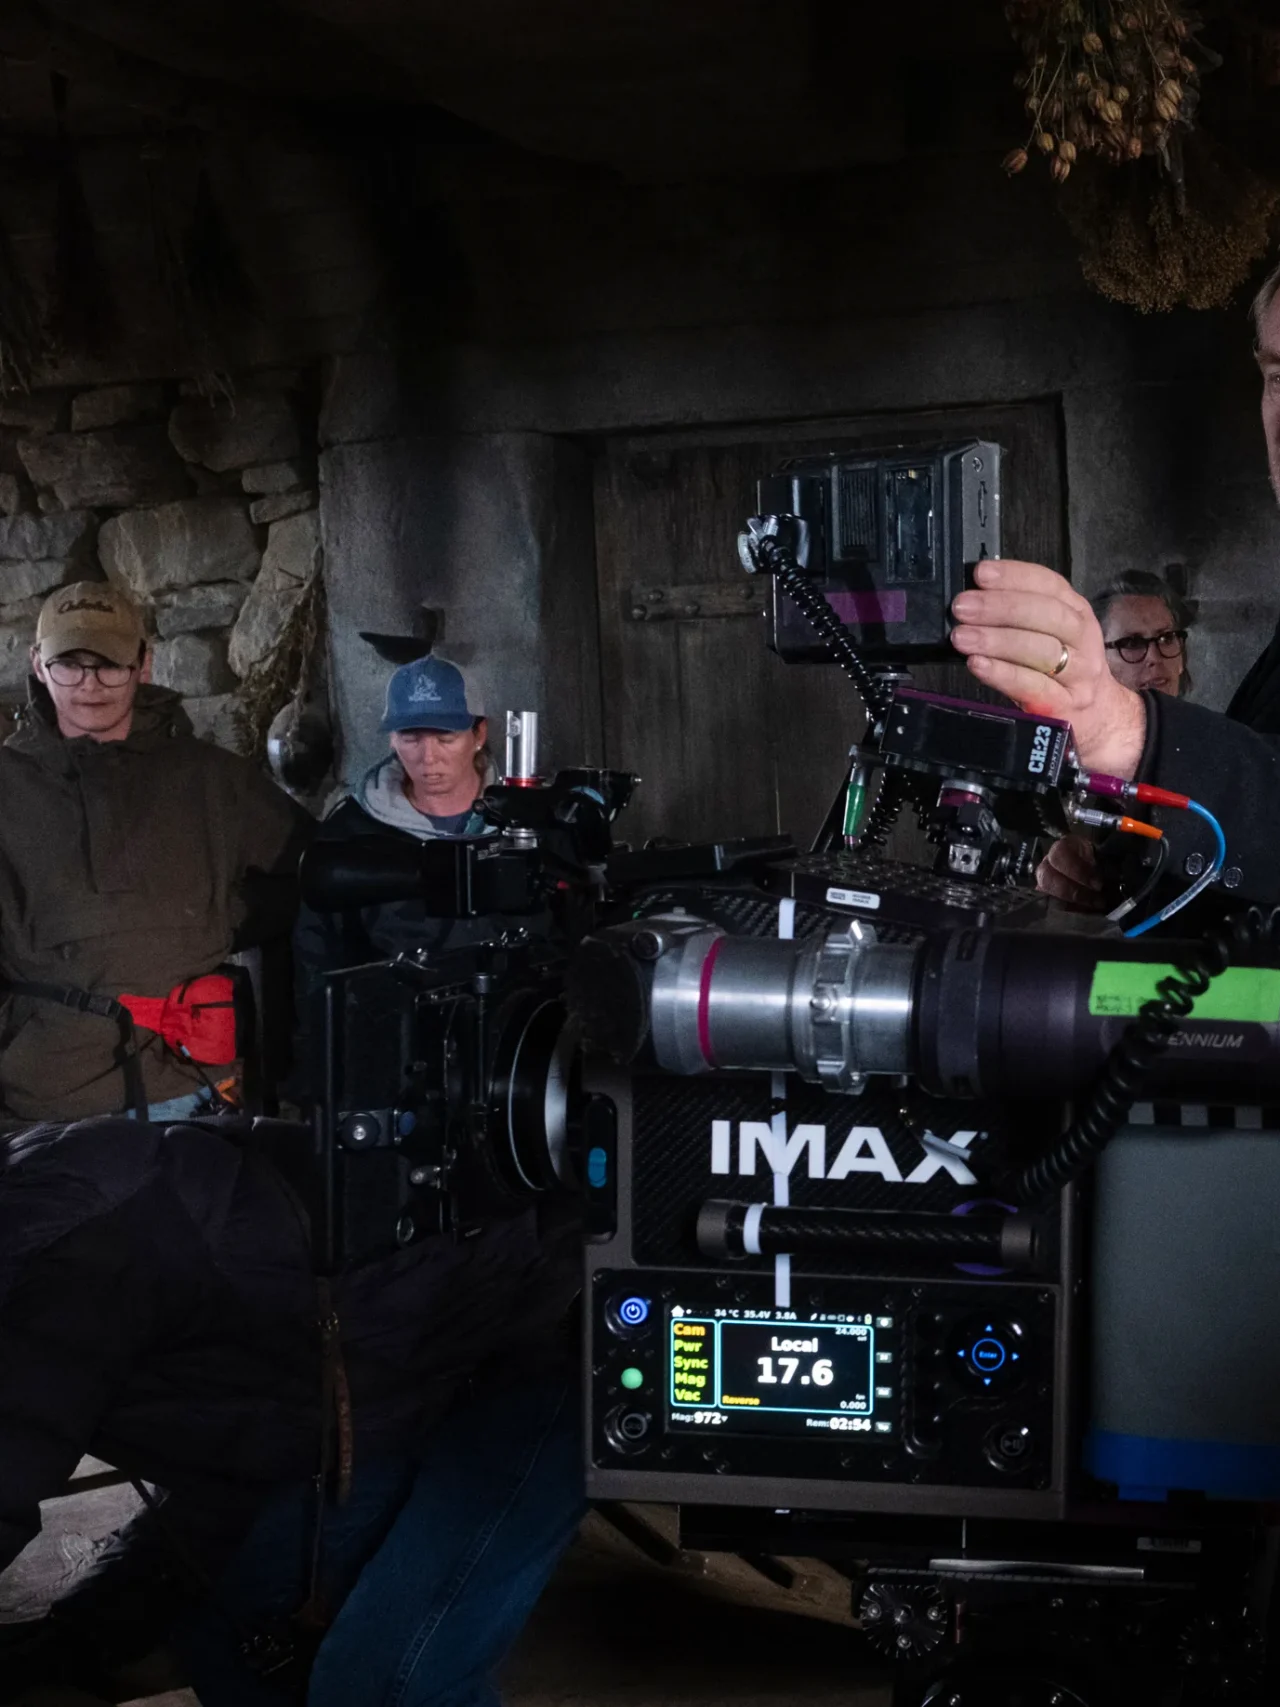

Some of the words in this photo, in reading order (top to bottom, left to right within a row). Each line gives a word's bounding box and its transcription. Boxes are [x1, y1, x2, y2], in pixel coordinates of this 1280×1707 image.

[1027, 725, 1052, 774] CH:23
[710, 1117, 980, 1187] IMAX
[673, 1322, 706, 1337] Cam
[673, 1339, 703, 1352] Pwr
[770, 1335, 819, 1353] Local
[673, 1355, 709, 1370] Sync
[757, 1356, 834, 1387] 17.6
[674, 1372, 706, 1388] Mag
[674, 1388, 701, 1402] Vac
[722, 1394, 761, 1406] Reverse
